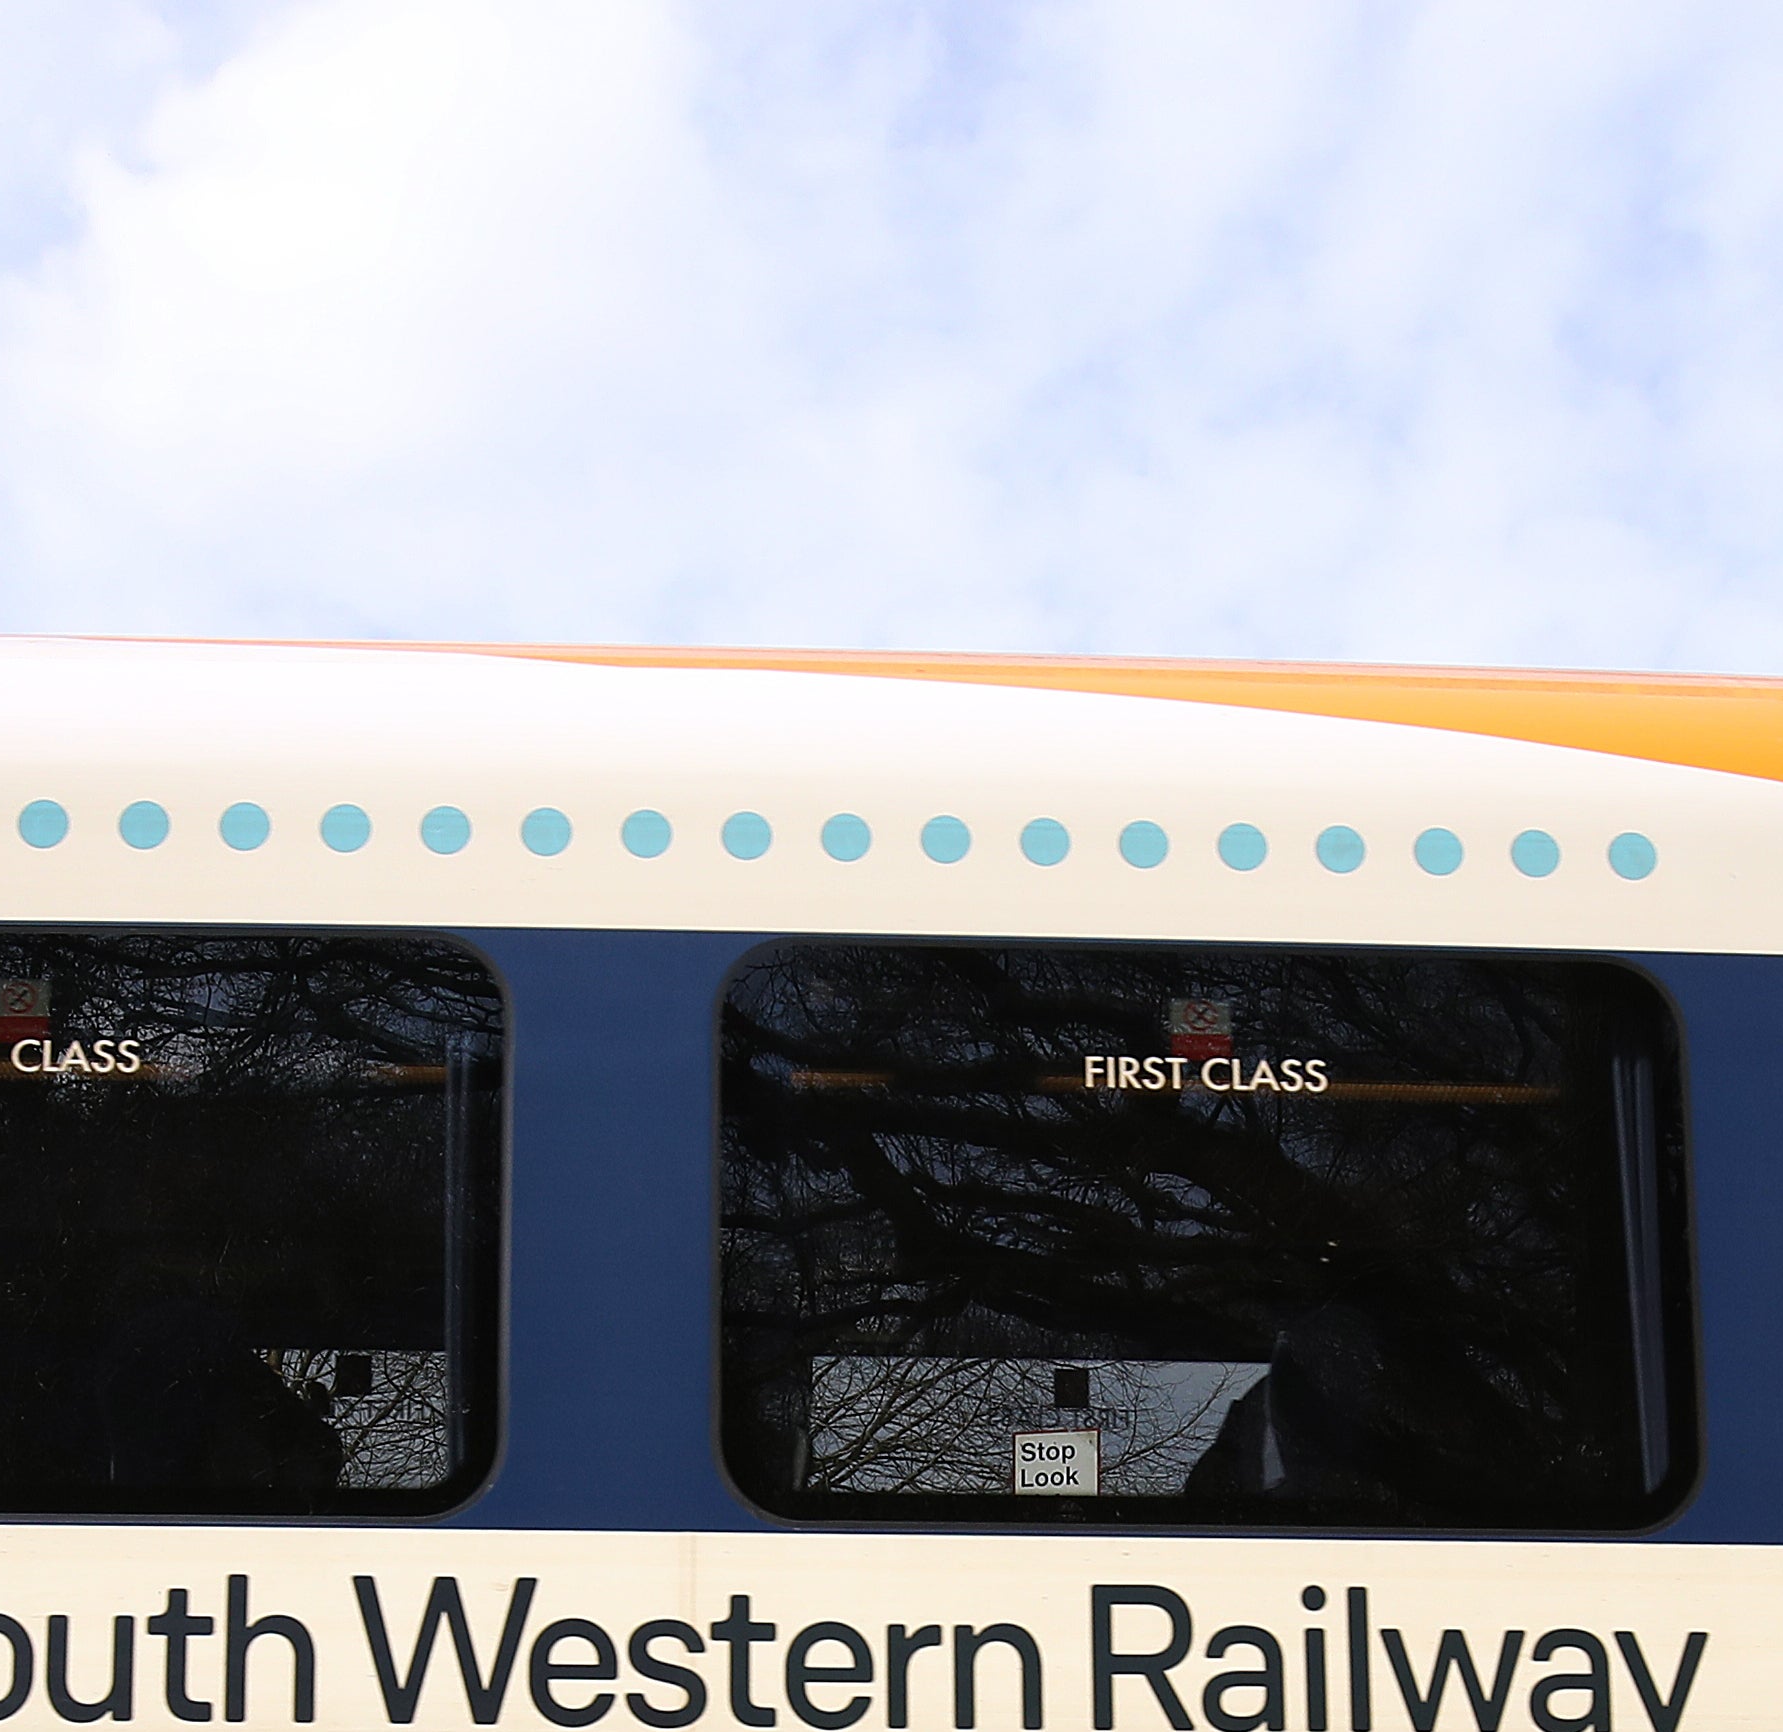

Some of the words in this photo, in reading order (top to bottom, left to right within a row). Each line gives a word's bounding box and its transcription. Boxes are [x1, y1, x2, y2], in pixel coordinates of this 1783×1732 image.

[10, 1038, 141, 1074] CLASS
[1084, 1055, 1189, 1091] FIRST
[1200, 1056, 1329, 1093] CLASS
[1019, 1441, 1077, 1465] Stop
[1019, 1465, 1081, 1489] Look
[351, 1574, 1044, 1732] Western
